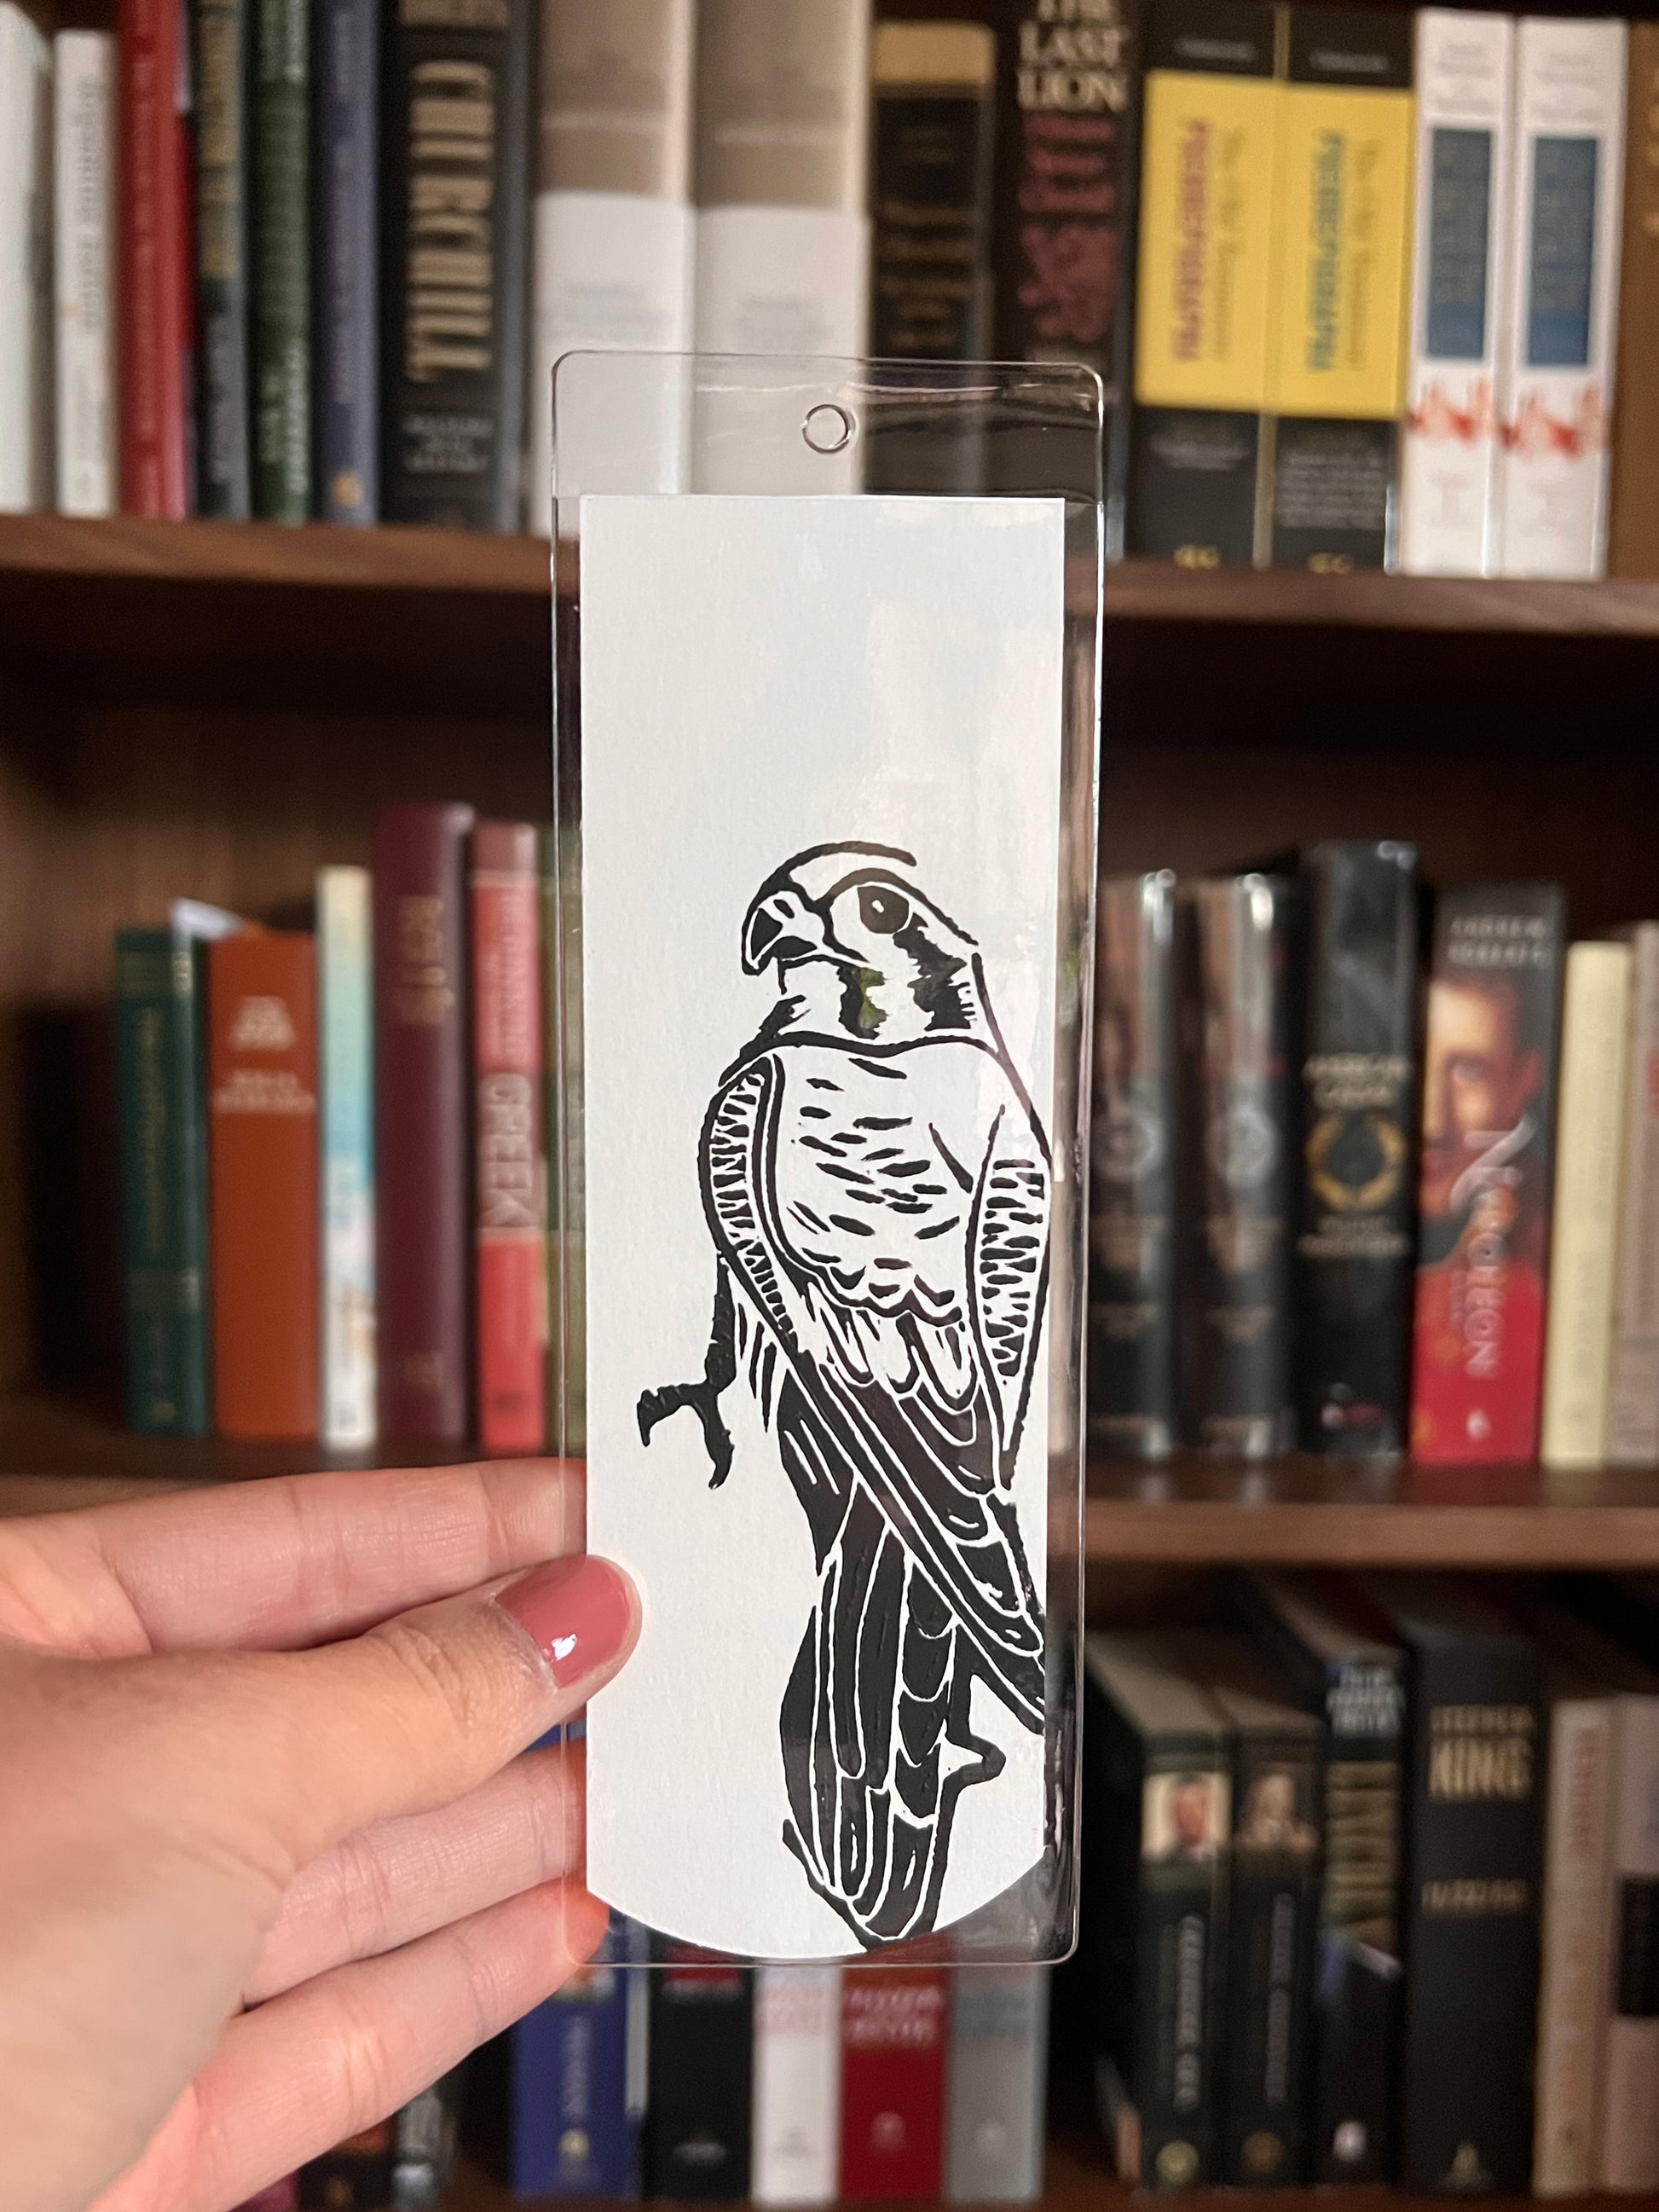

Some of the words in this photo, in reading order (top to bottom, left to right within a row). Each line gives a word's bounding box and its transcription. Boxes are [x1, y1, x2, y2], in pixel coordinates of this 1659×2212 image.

[1019, 20, 1124, 67] LAST
[1016, 68, 1128, 113] LION
[477, 1072, 535, 1229] GREEK
[1449, 1113, 1536, 1381] NAPOLEON
[1428, 1736, 1532, 1801] KING
